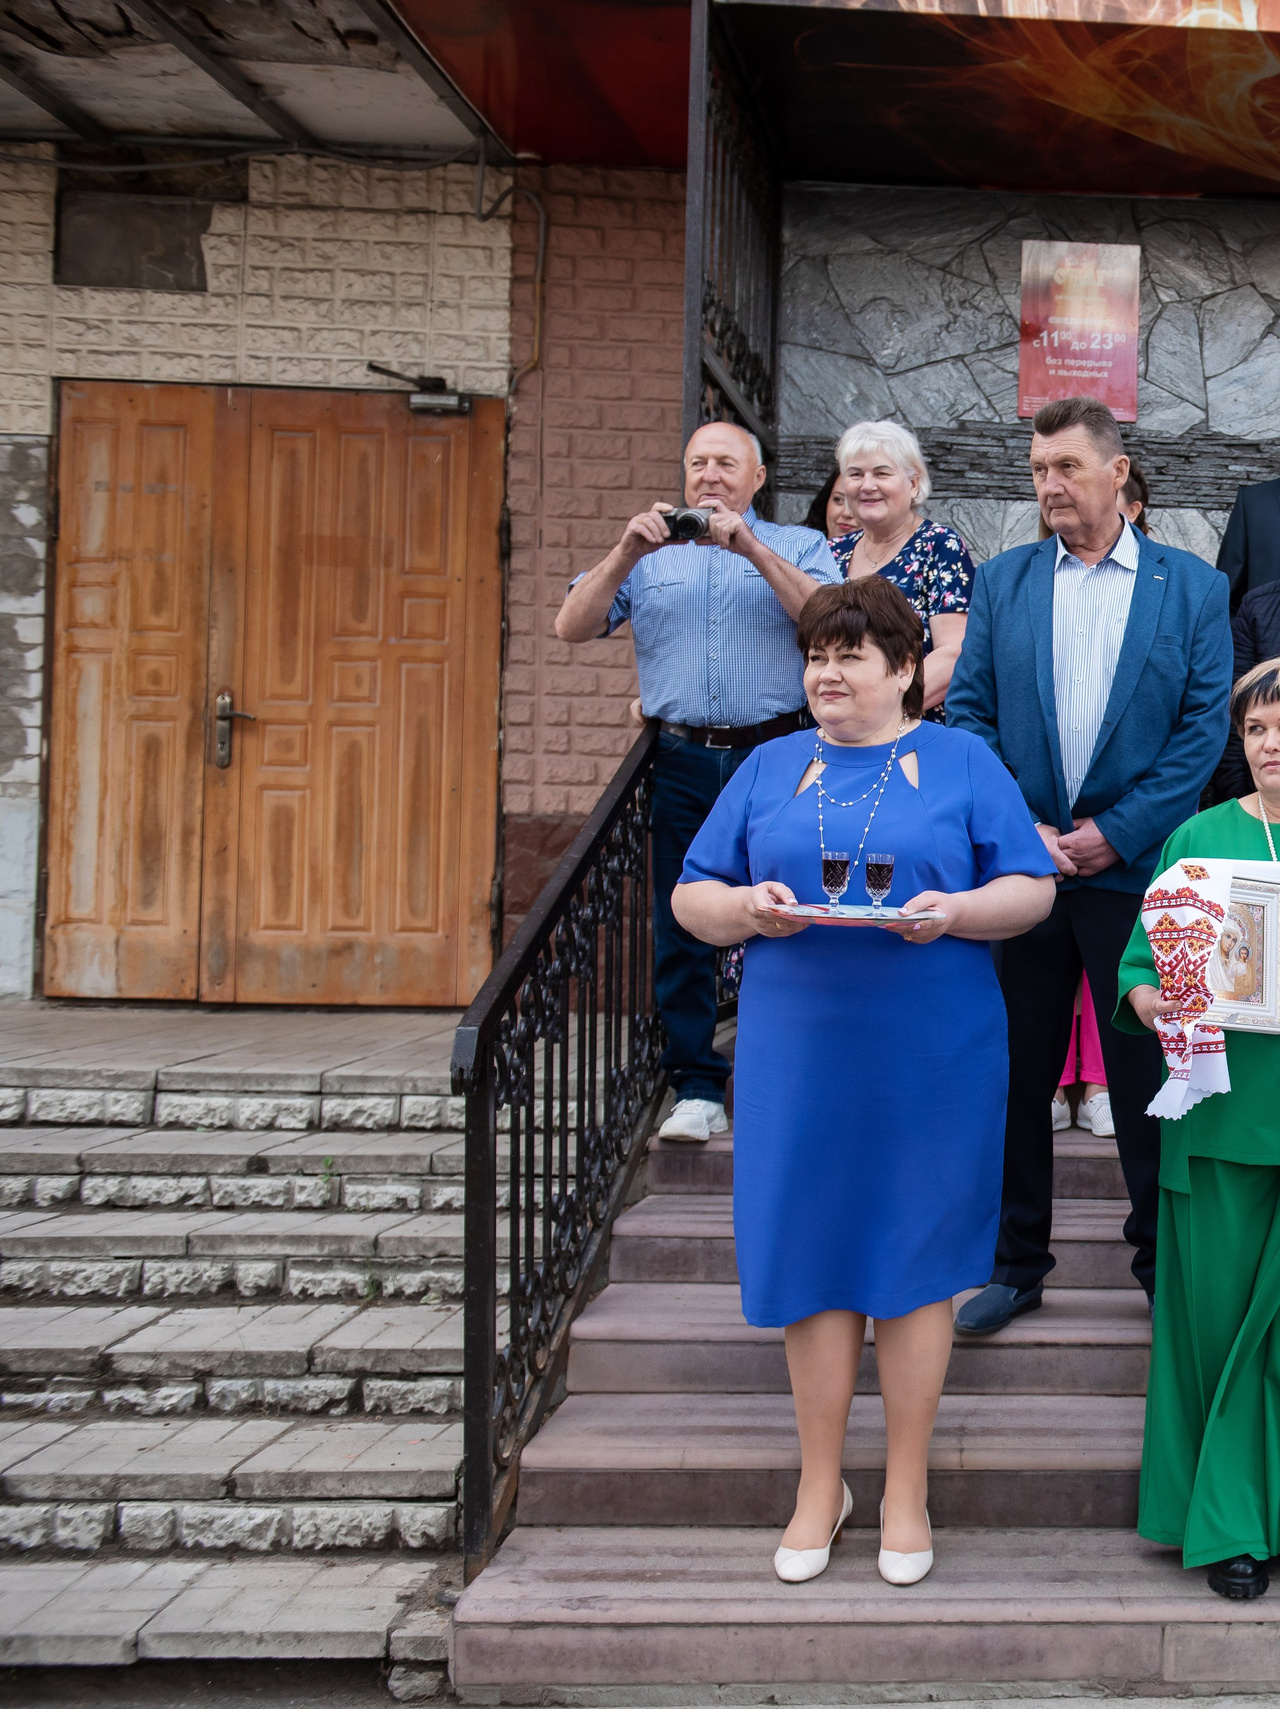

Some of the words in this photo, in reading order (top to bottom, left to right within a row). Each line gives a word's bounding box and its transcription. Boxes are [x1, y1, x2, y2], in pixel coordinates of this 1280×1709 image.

[1070, 341, 1087, 351] до
[1045, 356, 1062, 365] без
[1065, 359, 1113, 368] перерыва
[1057, 370, 1109, 378] выходных
